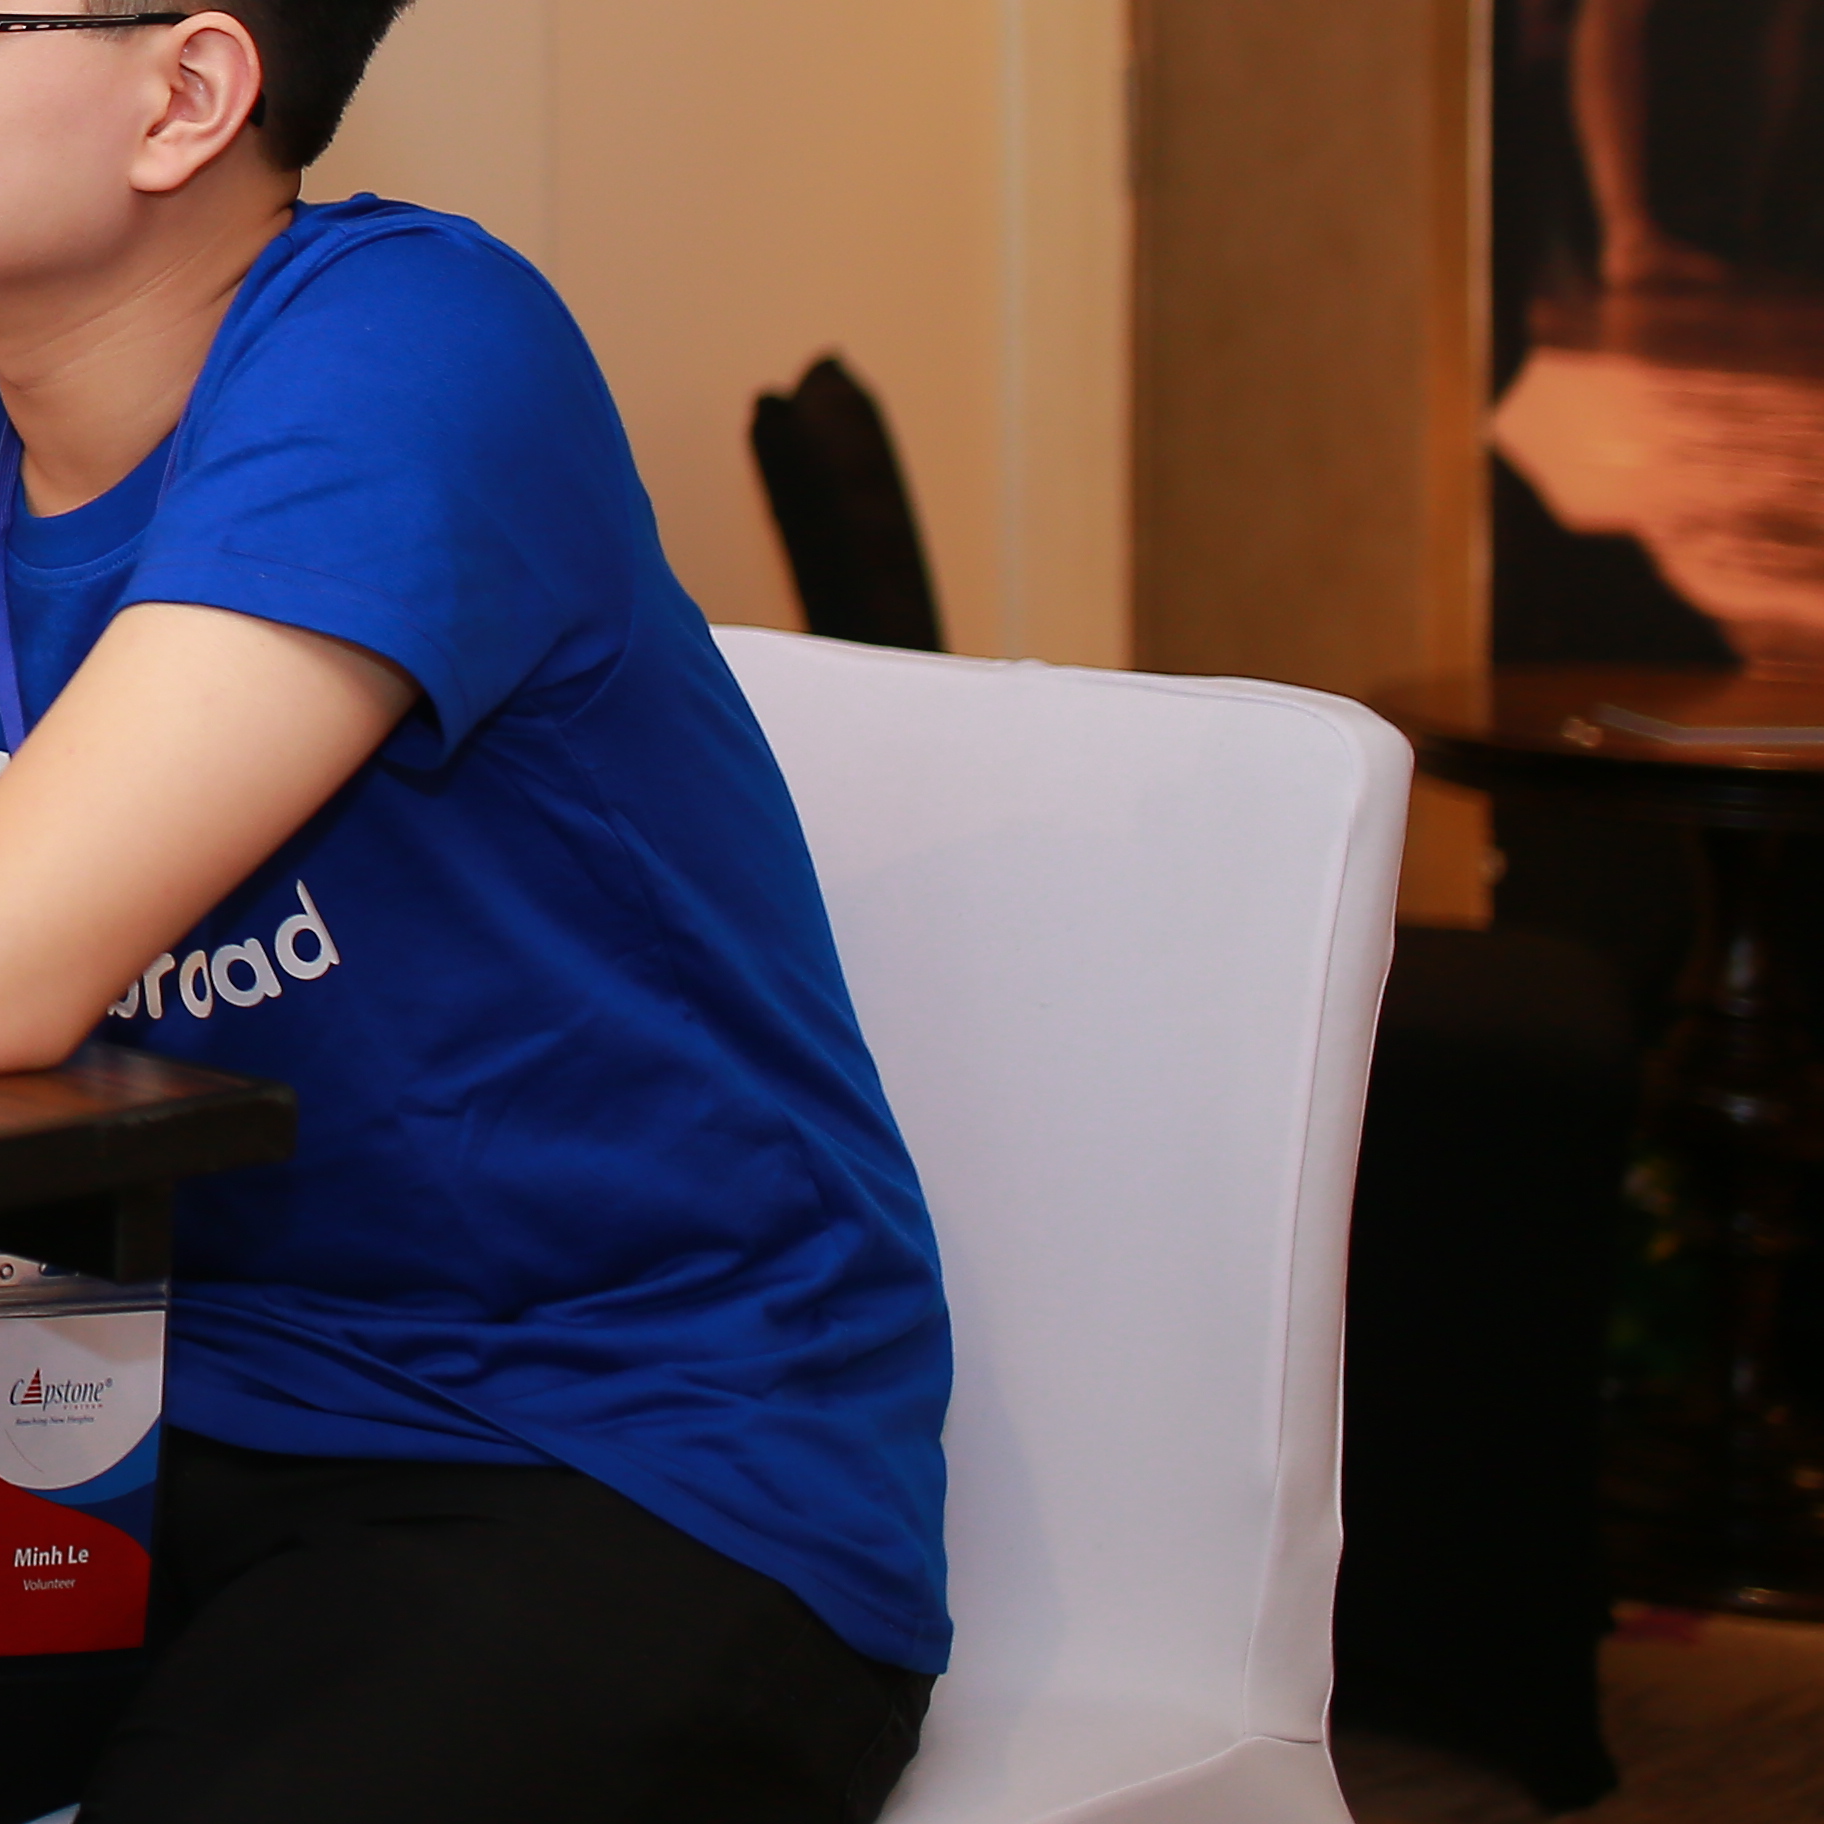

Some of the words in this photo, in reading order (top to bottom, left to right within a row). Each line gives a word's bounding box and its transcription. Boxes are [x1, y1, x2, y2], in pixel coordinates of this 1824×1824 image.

[14, 1545, 63, 1567] Minh
[67, 1545, 89, 1564] Le
[23, 1578, 76, 1591] Volunteer
